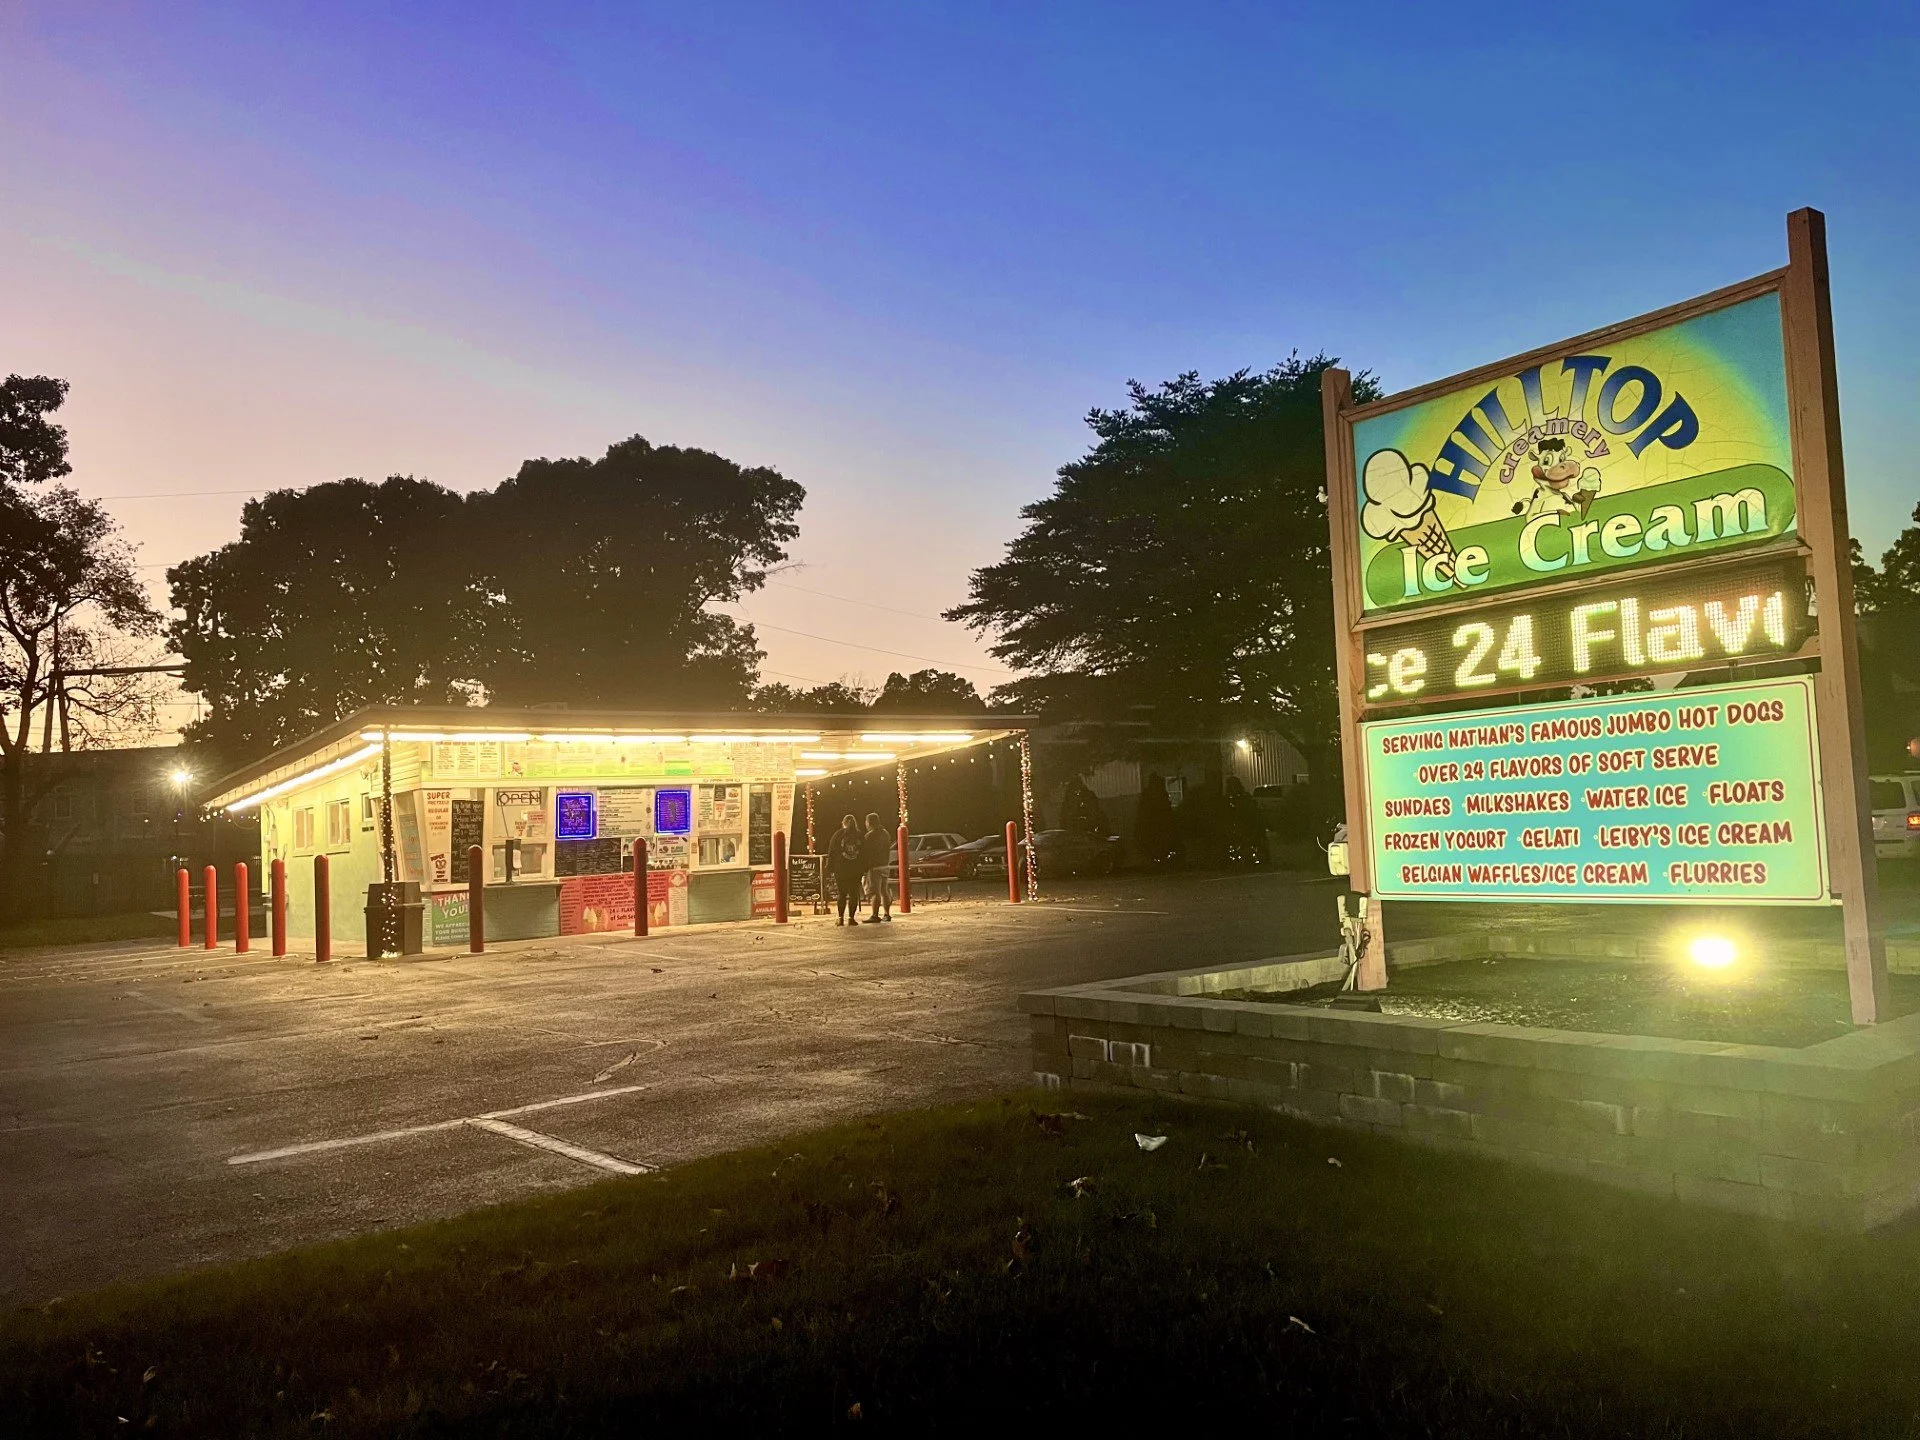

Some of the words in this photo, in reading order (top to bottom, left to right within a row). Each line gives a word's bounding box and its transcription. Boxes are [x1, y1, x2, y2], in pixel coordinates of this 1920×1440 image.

[1430, 356, 1699, 501] HILLTOP
[1500, 418, 1611, 484] creamery
[1401, 545, 1490, 597] Ice
[1518, 486, 1769, 571] Cream
[1453, 614, 1541, 688] 24
[1382, 733, 1442, 754] SERVING
[1449, 725, 1525, 747] NATHAN'S
[1531, 718, 1601, 740] FAMOUS
[1607, 711, 1671, 735] JUMBO
[1679, 706, 1718, 728] HOT
[1727, 700, 1784, 724] DOGS
[1419, 764, 1457, 783] OVER
[1464, 762, 1483, 779] 24
[1490, 757, 1562, 778] FLAVORS
[1569, 755, 1590, 773] OF
[1598, 750, 1644, 772] SOFT
[1653, 745, 1717, 768] SERVE
[427, 792, 450, 800] SUPER
[500, 792, 539, 805] OPEN
[1466, 792, 1569, 813] MILKSHAKES
[1586, 787, 1648, 808] WATER
[1655, 786, 1686, 805] ICE
[1709, 781, 1784, 803] FLOATS
[1385, 798, 1450, 817] SUNDAES
[1384, 833, 1439, 850] FROZEN
[1445, 830, 1505, 849] YOGURT
[1523, 829, 1578, 848] GELATI
[1600, 826, 1670, 847] LEIBY'S
[1678, 825, 1709, 845] ICE
[1718, 822, 1792, 844] CREAM
[1402, 865, 1462, 883] BELGIAN
[1468, 865, 1576, 884] WAFFLES/ICE
[1583, 864, 1647, 884] CREAM
[1670, 863, 1766, 884] FLURRIES
